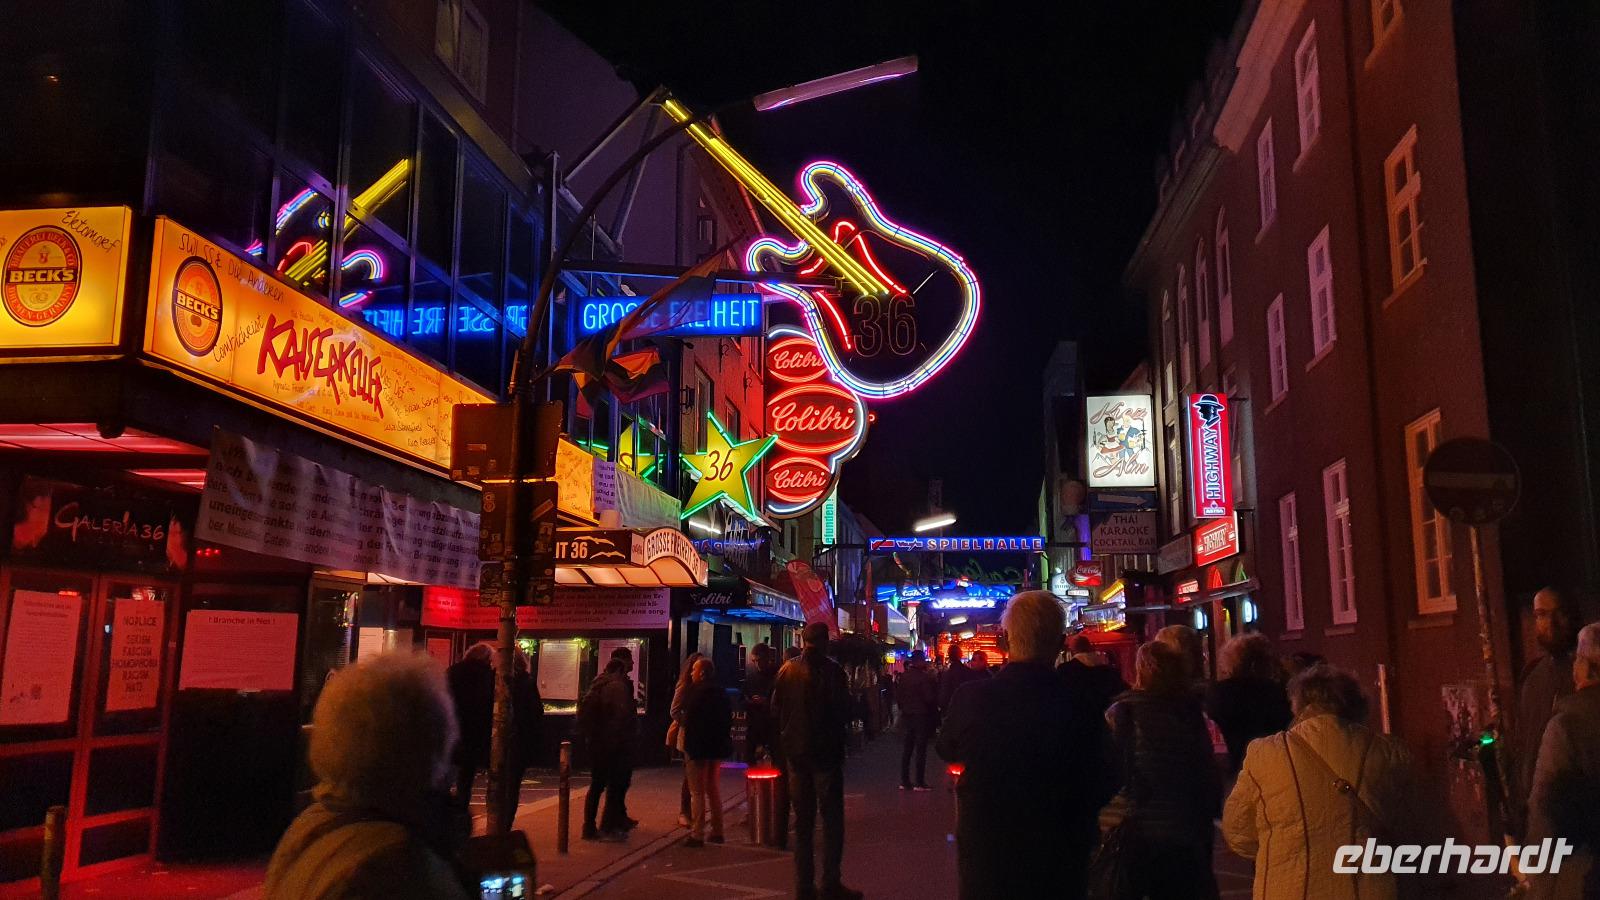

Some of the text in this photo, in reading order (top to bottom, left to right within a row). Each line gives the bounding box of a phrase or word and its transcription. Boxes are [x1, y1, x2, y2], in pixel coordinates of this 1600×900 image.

[9, 269, 74, 282] BECK'S
[177, 291, 218, 320] BECK'S
[853, 293, 916, 357] 36
[257, 313, 384, 419] KAISERKELLER
[772, 402, 856, 431] Colibri
[704, 449, 734, 481] 36
[1093, 453, 1149, 478] Alm
[1203, 428, 1220, 499] HIGHWAY
[774, 469, 826, 488] Colibri
[1113, 515, 1138, 524] THAI
[141, 525, 165, 540] 36
[1094, 538, 1136, 547] COCKTAIL
[1101, 527, 1149, 536] KARAOKE
[571, 542, 588, 559] 36
[646, 532, 670, 560] GROSSE
[927, 538, 1042, 551] SPIELHALLE
